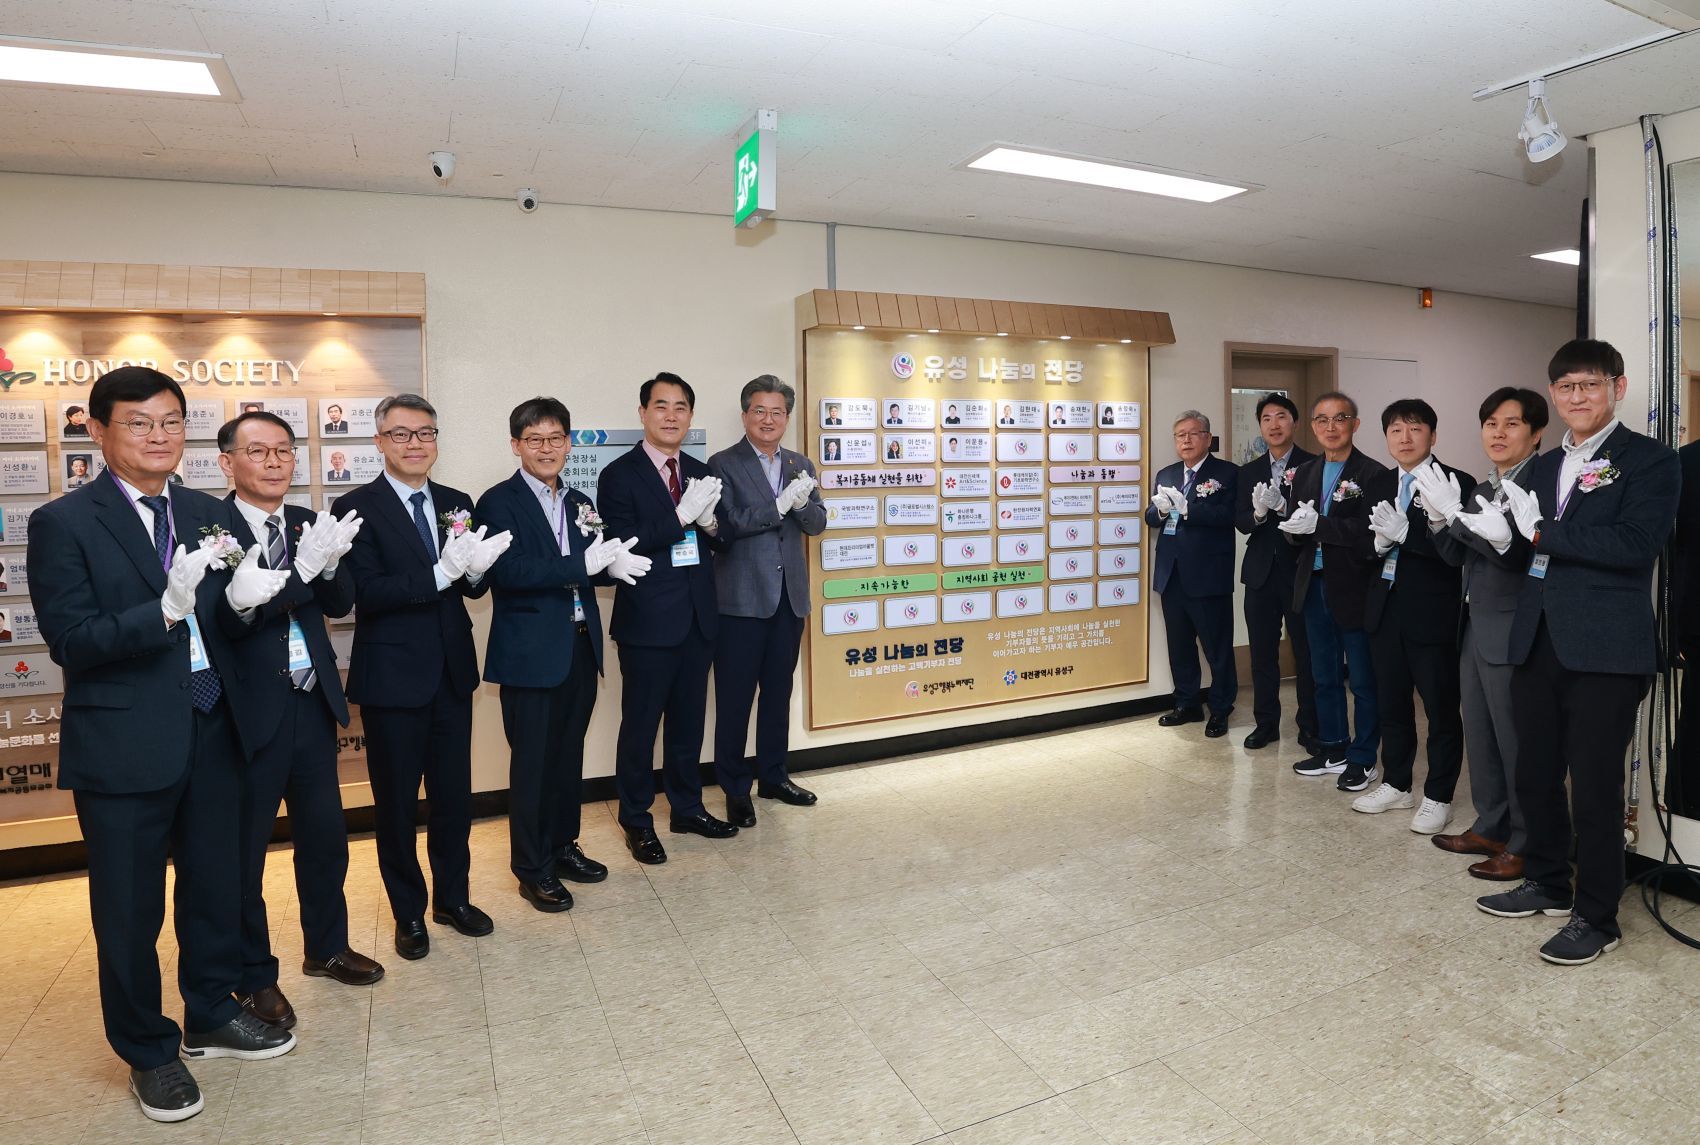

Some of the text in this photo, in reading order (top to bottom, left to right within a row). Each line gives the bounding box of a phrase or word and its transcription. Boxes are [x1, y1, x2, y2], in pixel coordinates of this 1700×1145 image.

[43, 358, 305, 384] HON SOCIETY
[924, 355, 1084, 384] 유성 나눔의 전당
[690, 431, 701, 440] 3F
[563, 467, 597, 476] 중회의실
[836, 472, 923, 486] 복지공동체 실현을 위한
[1071, 468, 1116, 480] 나눔과 동행
[956, 570, 1026, 584] 지역사회 공헌 실천
[986, 631, 1000, 640] 유성
[1004, 630, 1024, 639] 나눔의
[1026, 627, 1045, 636] 전당은
[1048, 624, 1080, 634] 지역사회에
[1006, 637, 1039, 647] 기부자들의
[1057, 633, 1075, 642] 기리고
[1087, 630, 1104, 638] 가치를
[845, 637, 964, 666] 유성 나눔의 전당
[992, 647, 1026, 657] 이어가고자
[1028, 646, 1041, 654] 하는
[1081, 637, 1113, 648] 공간입니다.
[849, 668, 873, 677] 나눔을
[876, 663, 906, 675] 실천하는
[948, 656, 962, 666] 전당
[1020, 666, 1074, 680] 대전광역시 유성구
[0, 762, 51, 784] 열매
